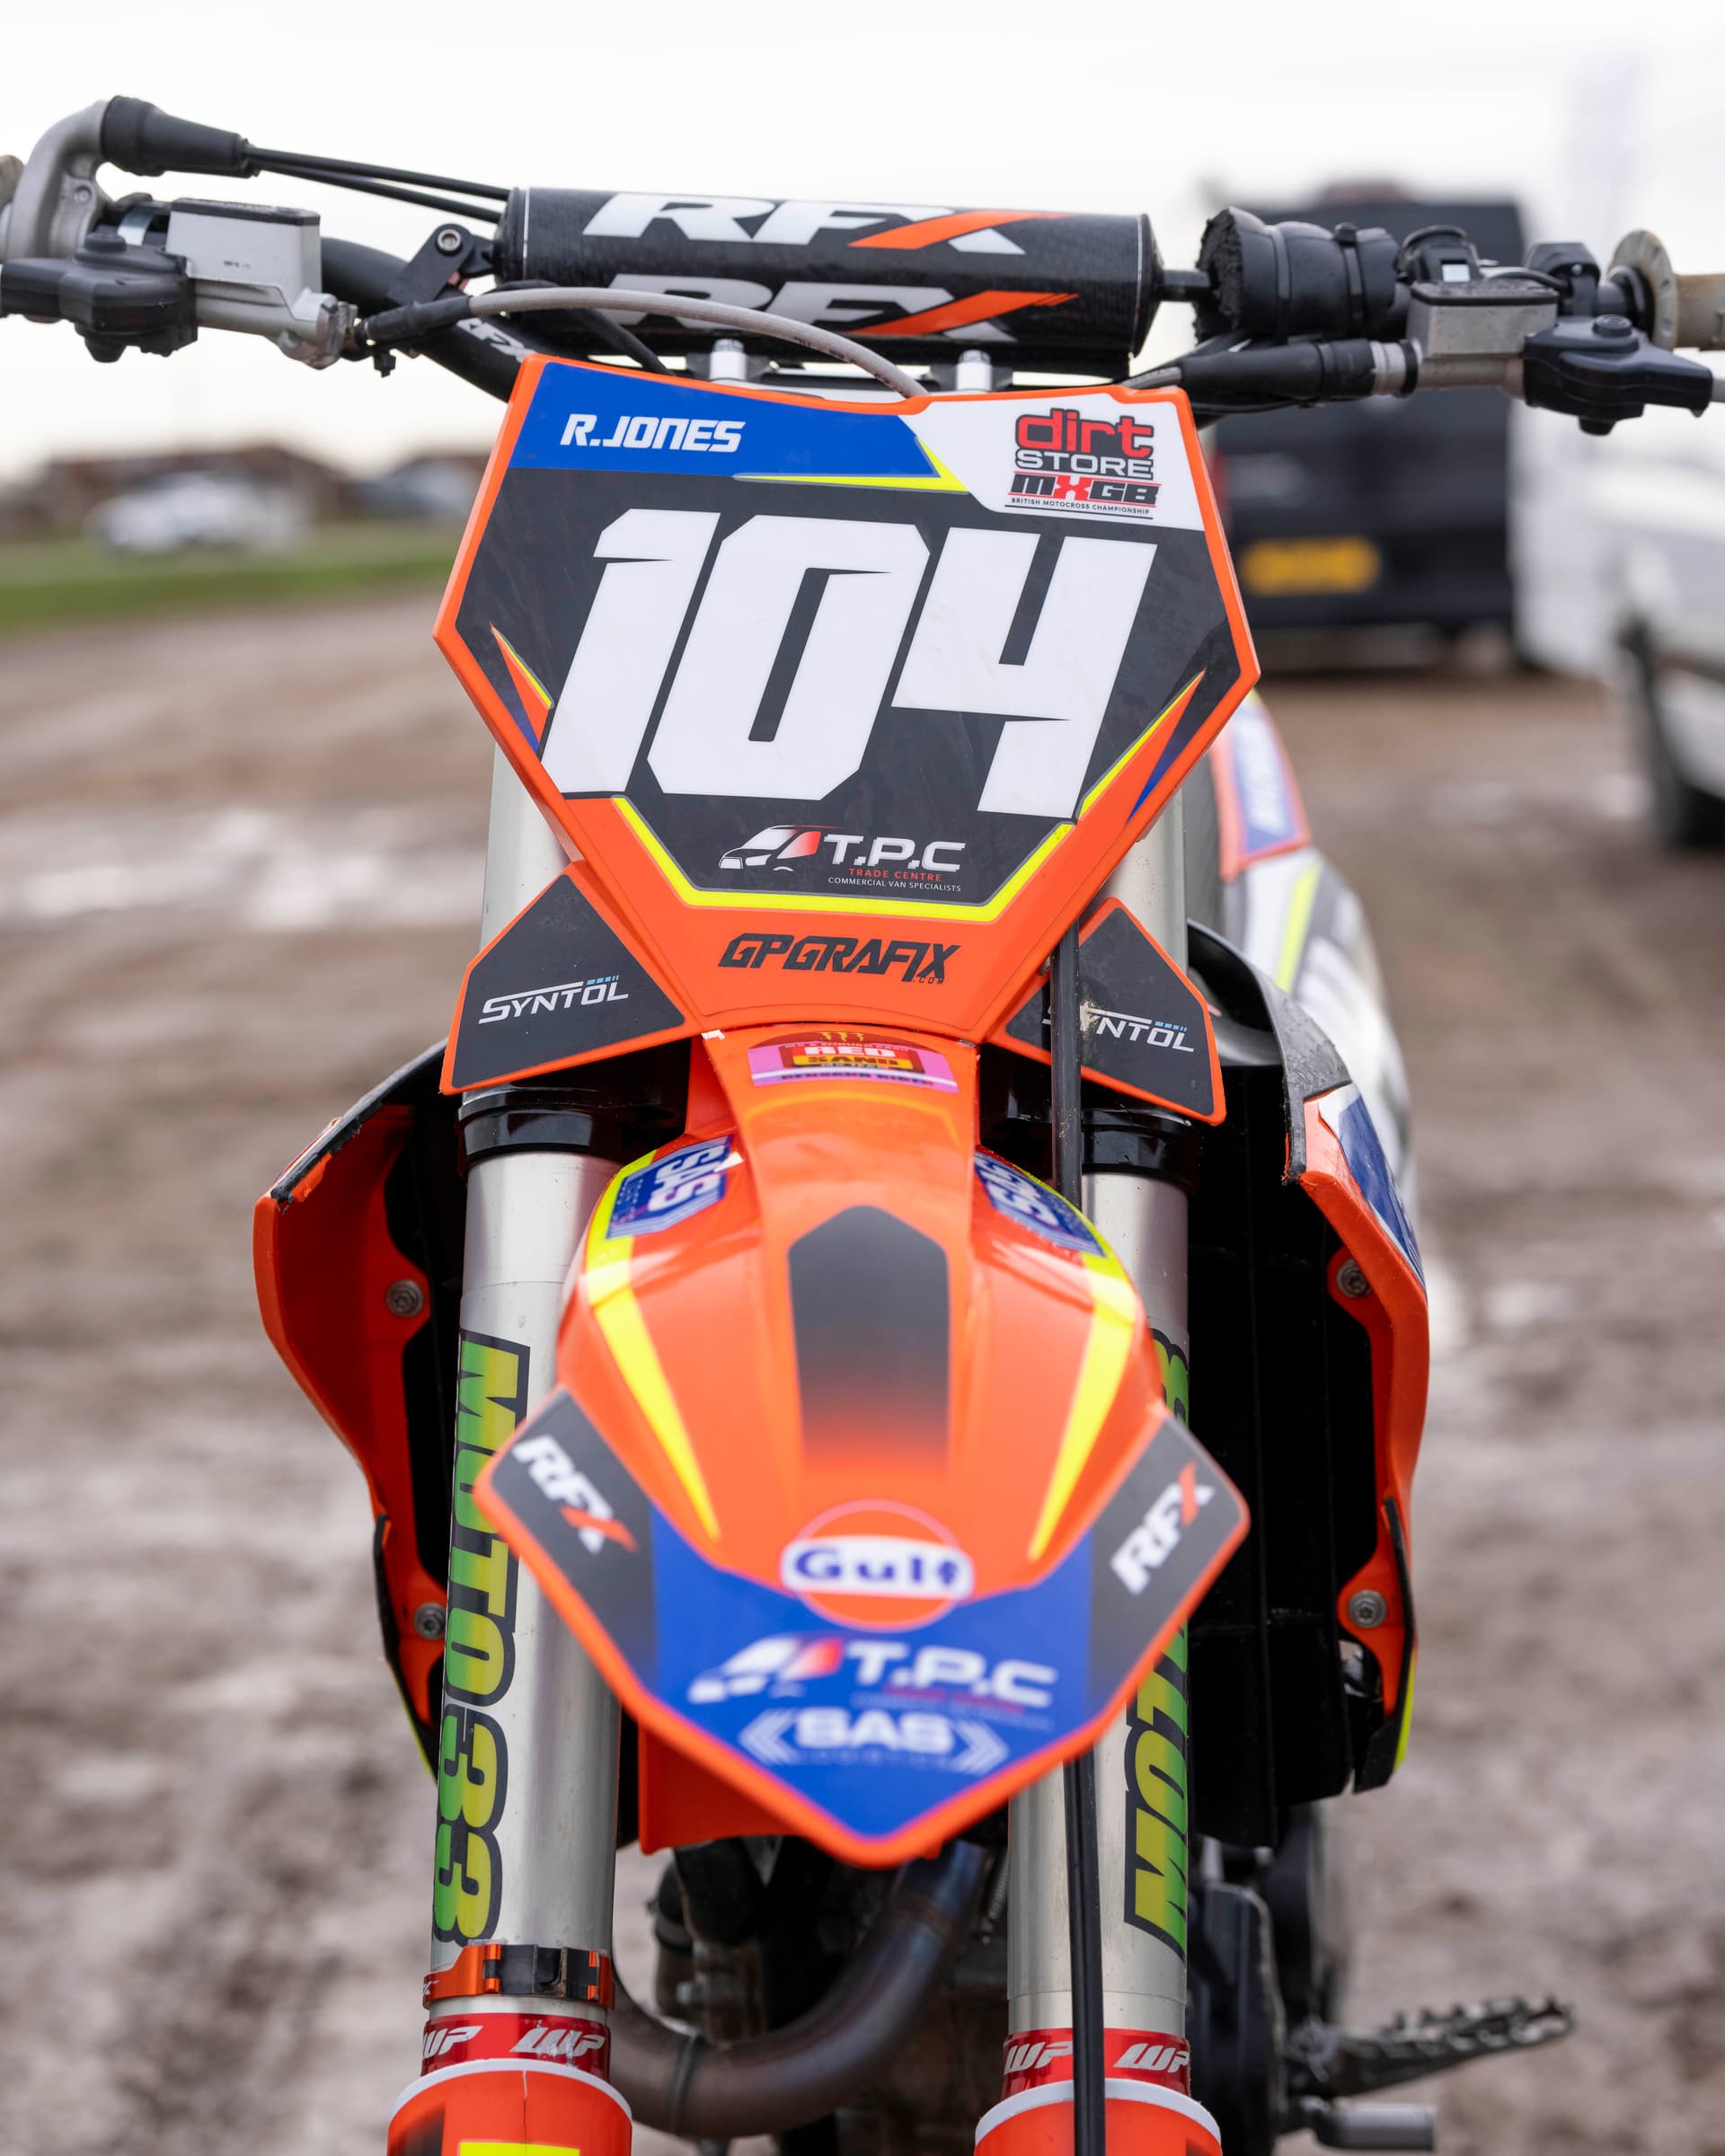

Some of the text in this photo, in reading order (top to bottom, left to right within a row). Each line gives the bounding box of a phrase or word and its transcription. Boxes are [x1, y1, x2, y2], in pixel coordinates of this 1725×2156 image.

[583, 191, 1075, 256] RFX
[560, 413, 746, 453] R.JONES
[1015, 408, 1154, 459] dirt
[1015, 448, 1154, 481] STORE
[1012, 498, 1150, 516] BRITISH MOTOCROSS CHAMPIONSHIP
[540, 508, 1157, 818] 104
[824, 834, 966, 872] T.P.C
[828, 877, 961, 892] COMMERCIAL VAN SPECIALISTS
[849, 868, 942, 882] TRADE CENTRE
[719, 932, 961, 982] GPGRAFIX
[478, 979, 629, 1025] SYNTOL
[804, 1045, 896, 1057] RED
[511, 1435, 640, 1556] RFX
[1110, 1457, 1215, 1596] RFX
[796, 1547, 961, 1587] Gulf
[509, 2025, 606, 2057] WP
[1113, 2042, 1190, 2073] WP
